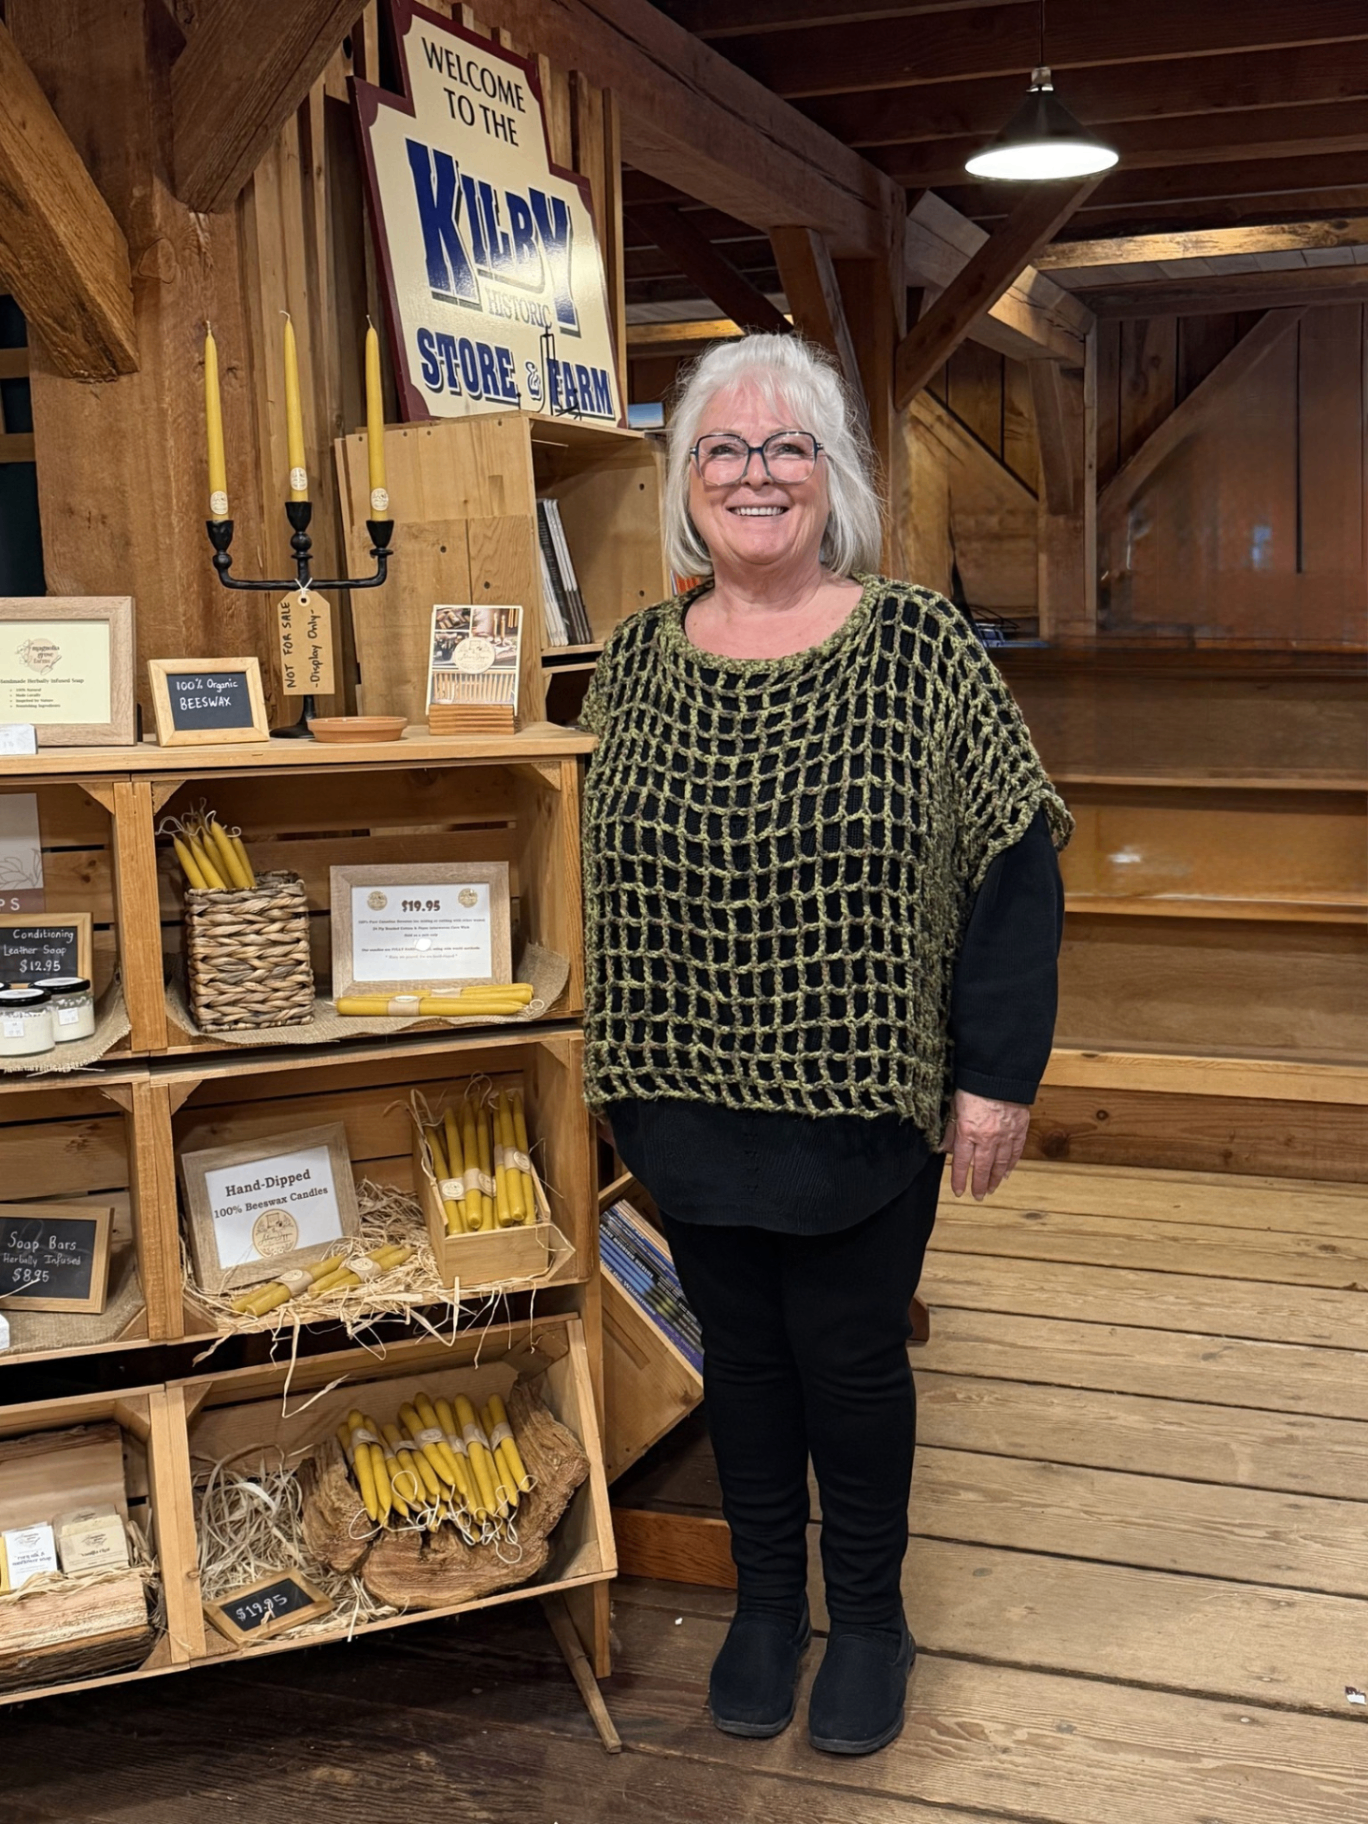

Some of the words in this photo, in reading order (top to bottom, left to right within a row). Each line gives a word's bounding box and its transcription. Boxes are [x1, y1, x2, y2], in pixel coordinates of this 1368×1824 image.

[422, 37, 525, 113] WELCOME
[444, 87, 475, 127] TO
[479, 105, 519, 147] THE
[405, 138, 582, 338] KILBY
[486, 288, 553, 329] HISTORIC
[416, 327, 519, 406] STORE
[525, 361, 543, 402] &
[546, 357, 616, 421] FARM
[280, 601, 292, 629] SALE
[282, 633, 294, 656] FOR
[176, 679, 203, 691] 100%
[207, 677, 239, 693] Organic
[284, 663, 297, 689] NOT
[180, 697, 232, 711] BEESWAX
[401, 900, 441, 913] $19.95
[13, 929, 74, 944] Conditioning
[3, 944, 38, 956] Leather
[43, 944, 67, 957] Soap
[19, 958, 61, 973] $12.95
[225, 1169, 311, 1197] Hand-Dipped
[214, 1205, 243, 1219] 100%
[245, 1196, 287, 1212] Beeswax
[290, 1187, 328, 1201] Candles
[7, 1231, 39, 1252] Soap
[49, 1235, 77, 1250] Bars
[44, 1253, 81, 1267] Infused
[235, 1594, 288, 1622] $19.95
